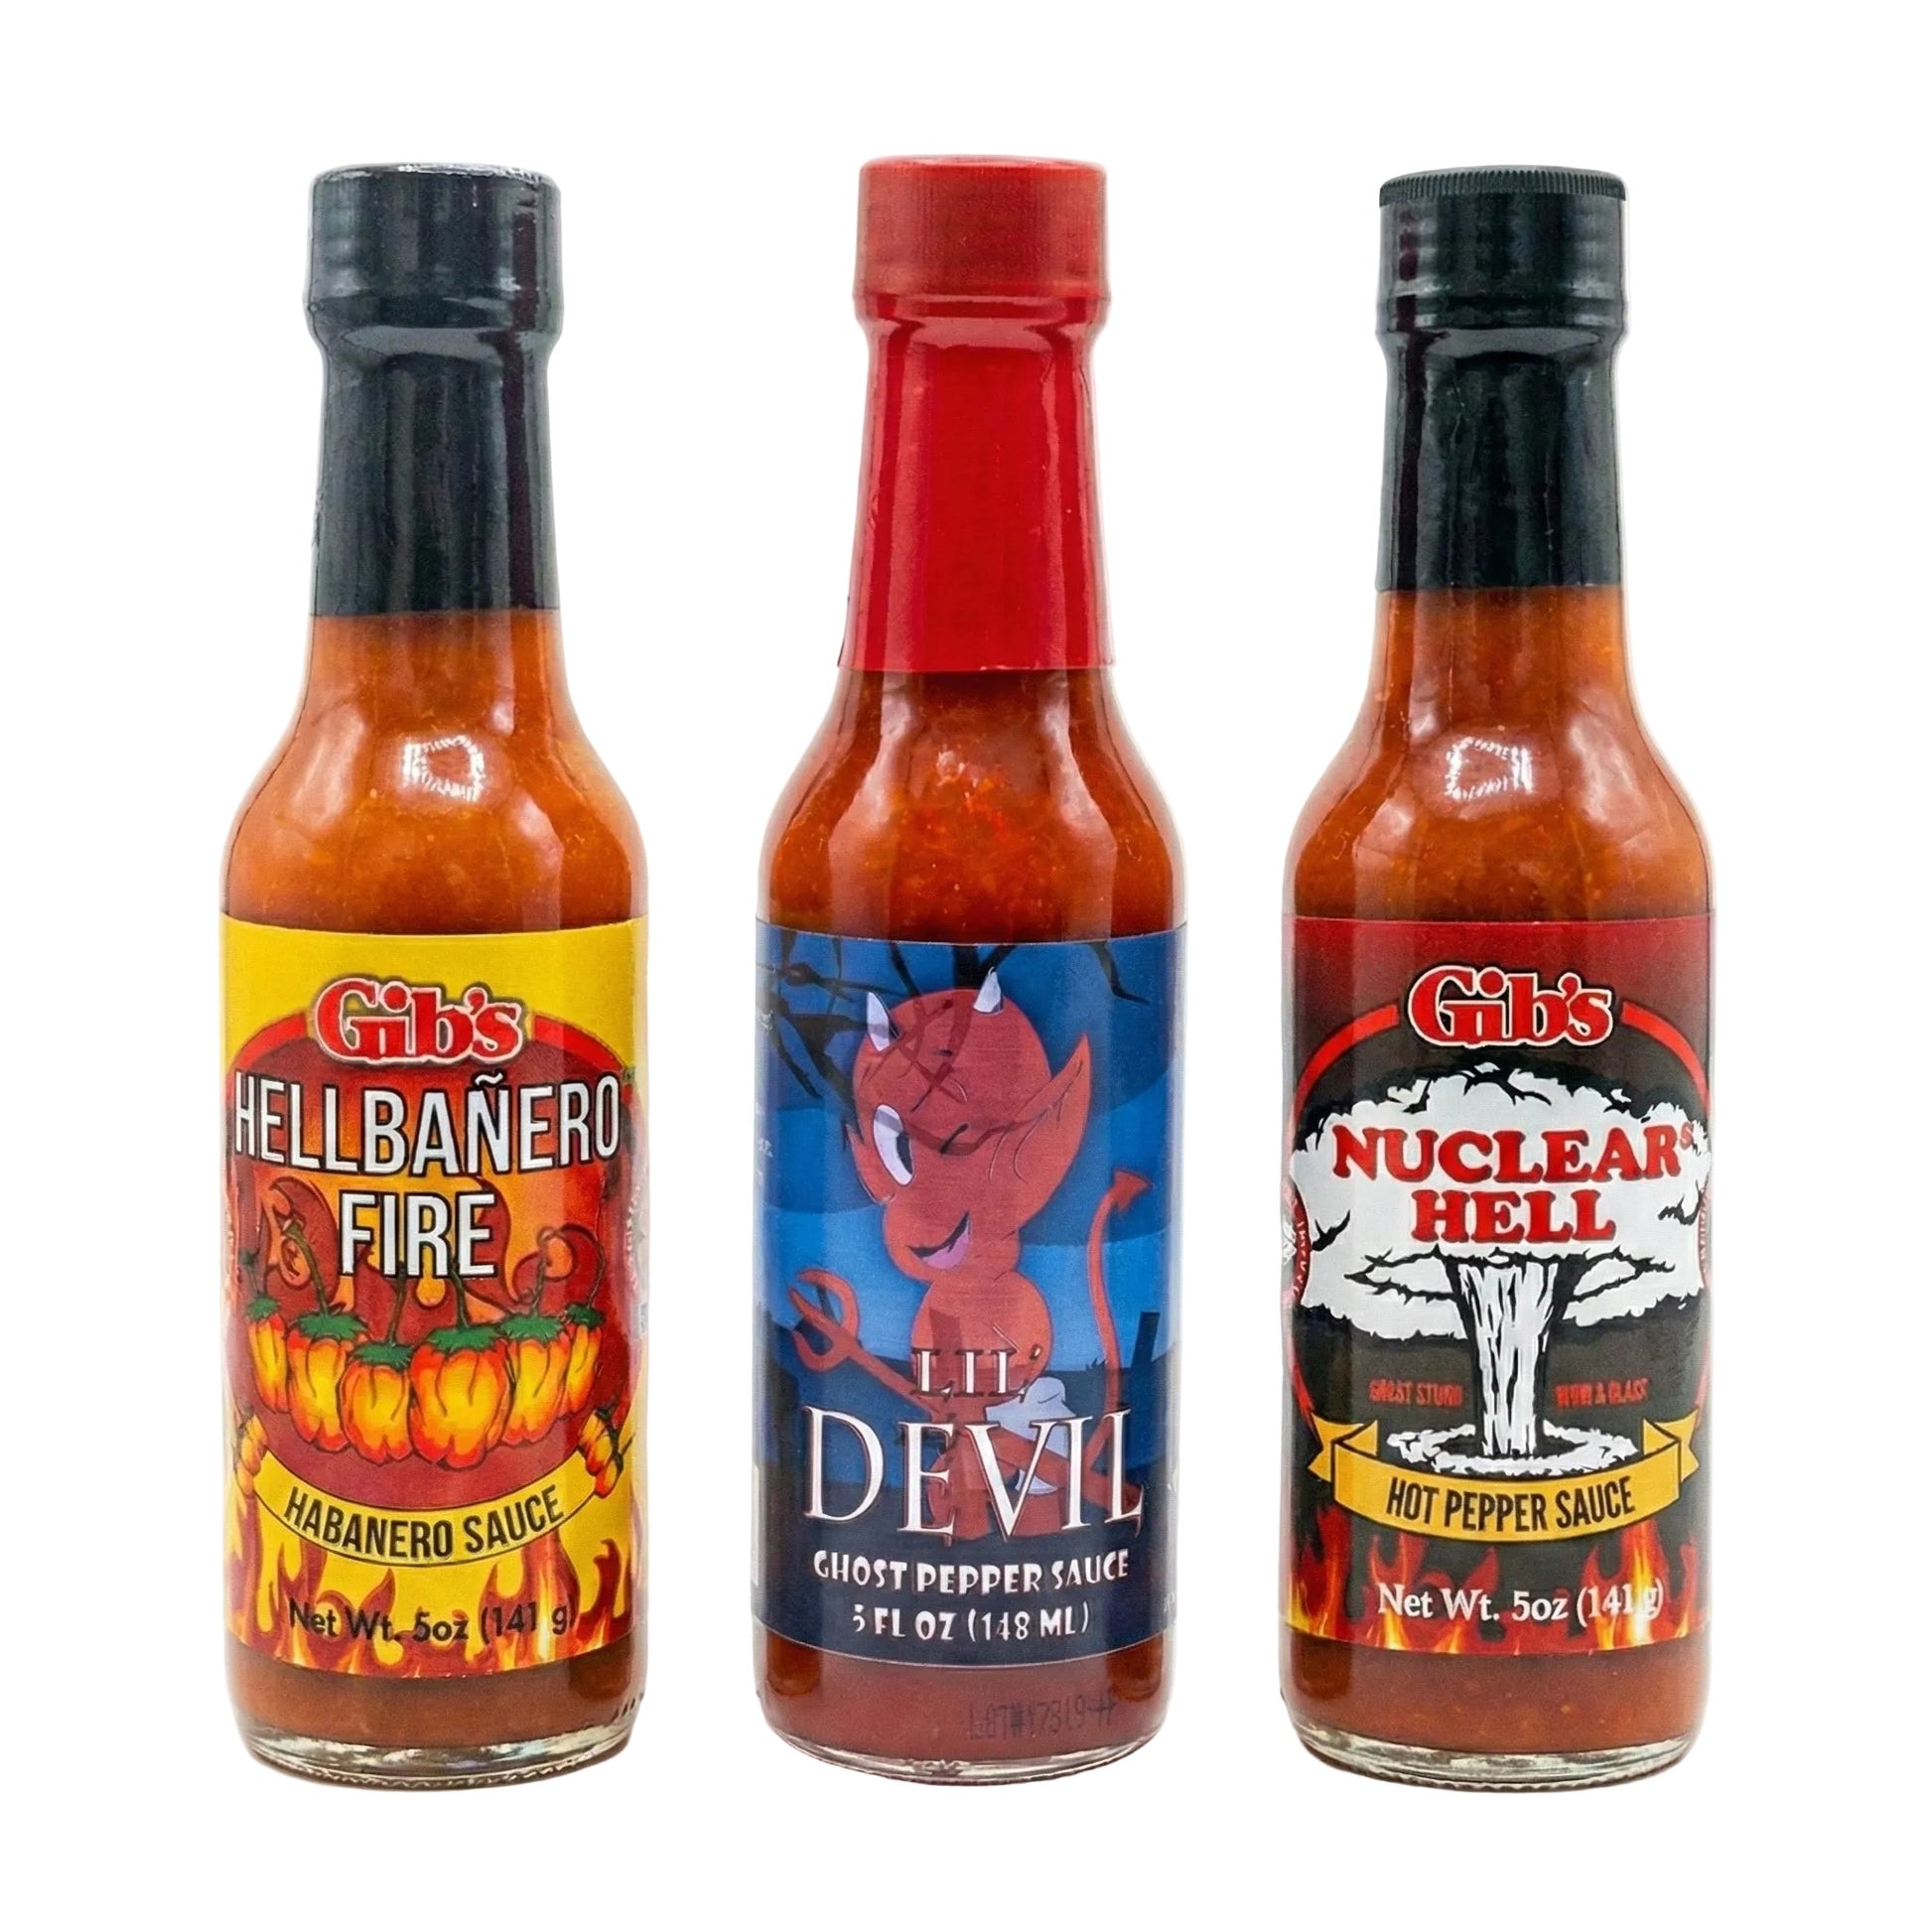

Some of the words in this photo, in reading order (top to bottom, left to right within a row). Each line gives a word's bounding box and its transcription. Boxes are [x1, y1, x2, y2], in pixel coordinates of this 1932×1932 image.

[315, 977, 523, 1064] Gib's
[1408, 965, 1613, 1047] Gib's
[234, 1069, 621, 1176] HELLBAÑERO
[339, 1188, 496, 1279] FIRE
[1411, 1189, 1616, 1244] HELL
[803, 1405, 1144, 1545] DEVIL
[1385, 1477, 1441, 1521] HOT
[1445, 1489, 1548, 1534] PEPPER
[1556, 1475, 1635, 1530] SAUCE
[284, 1486, 454, 1559] HABANERO
[463, 1484, 564, 1552] SAUCE
[813, 1549, 907, 1591] GHOST
[915, 1563, 1042, 1595] PEPPER
[1050, 1548, 1129, 1591] SAUCE
[1377, 1582, 1434, 1618] Net
[1440, 1587, 1500, 1622] Wt.
[1511, 1589, 1569, 1621] 5oz
[1577, 1584, 1631, 1627] (141
[288, 1597, 338, 1637] Net
[345, 1604, 398, 1641] Wt.
[413, 1607, 470, 1642] 5oz
[481, 1601, 537, 1646] (141
[874, 1606, 905, 1637] FL
[914, 1610, 957, 1641] OZ
[967, 1607, 1031, 1643] (148
